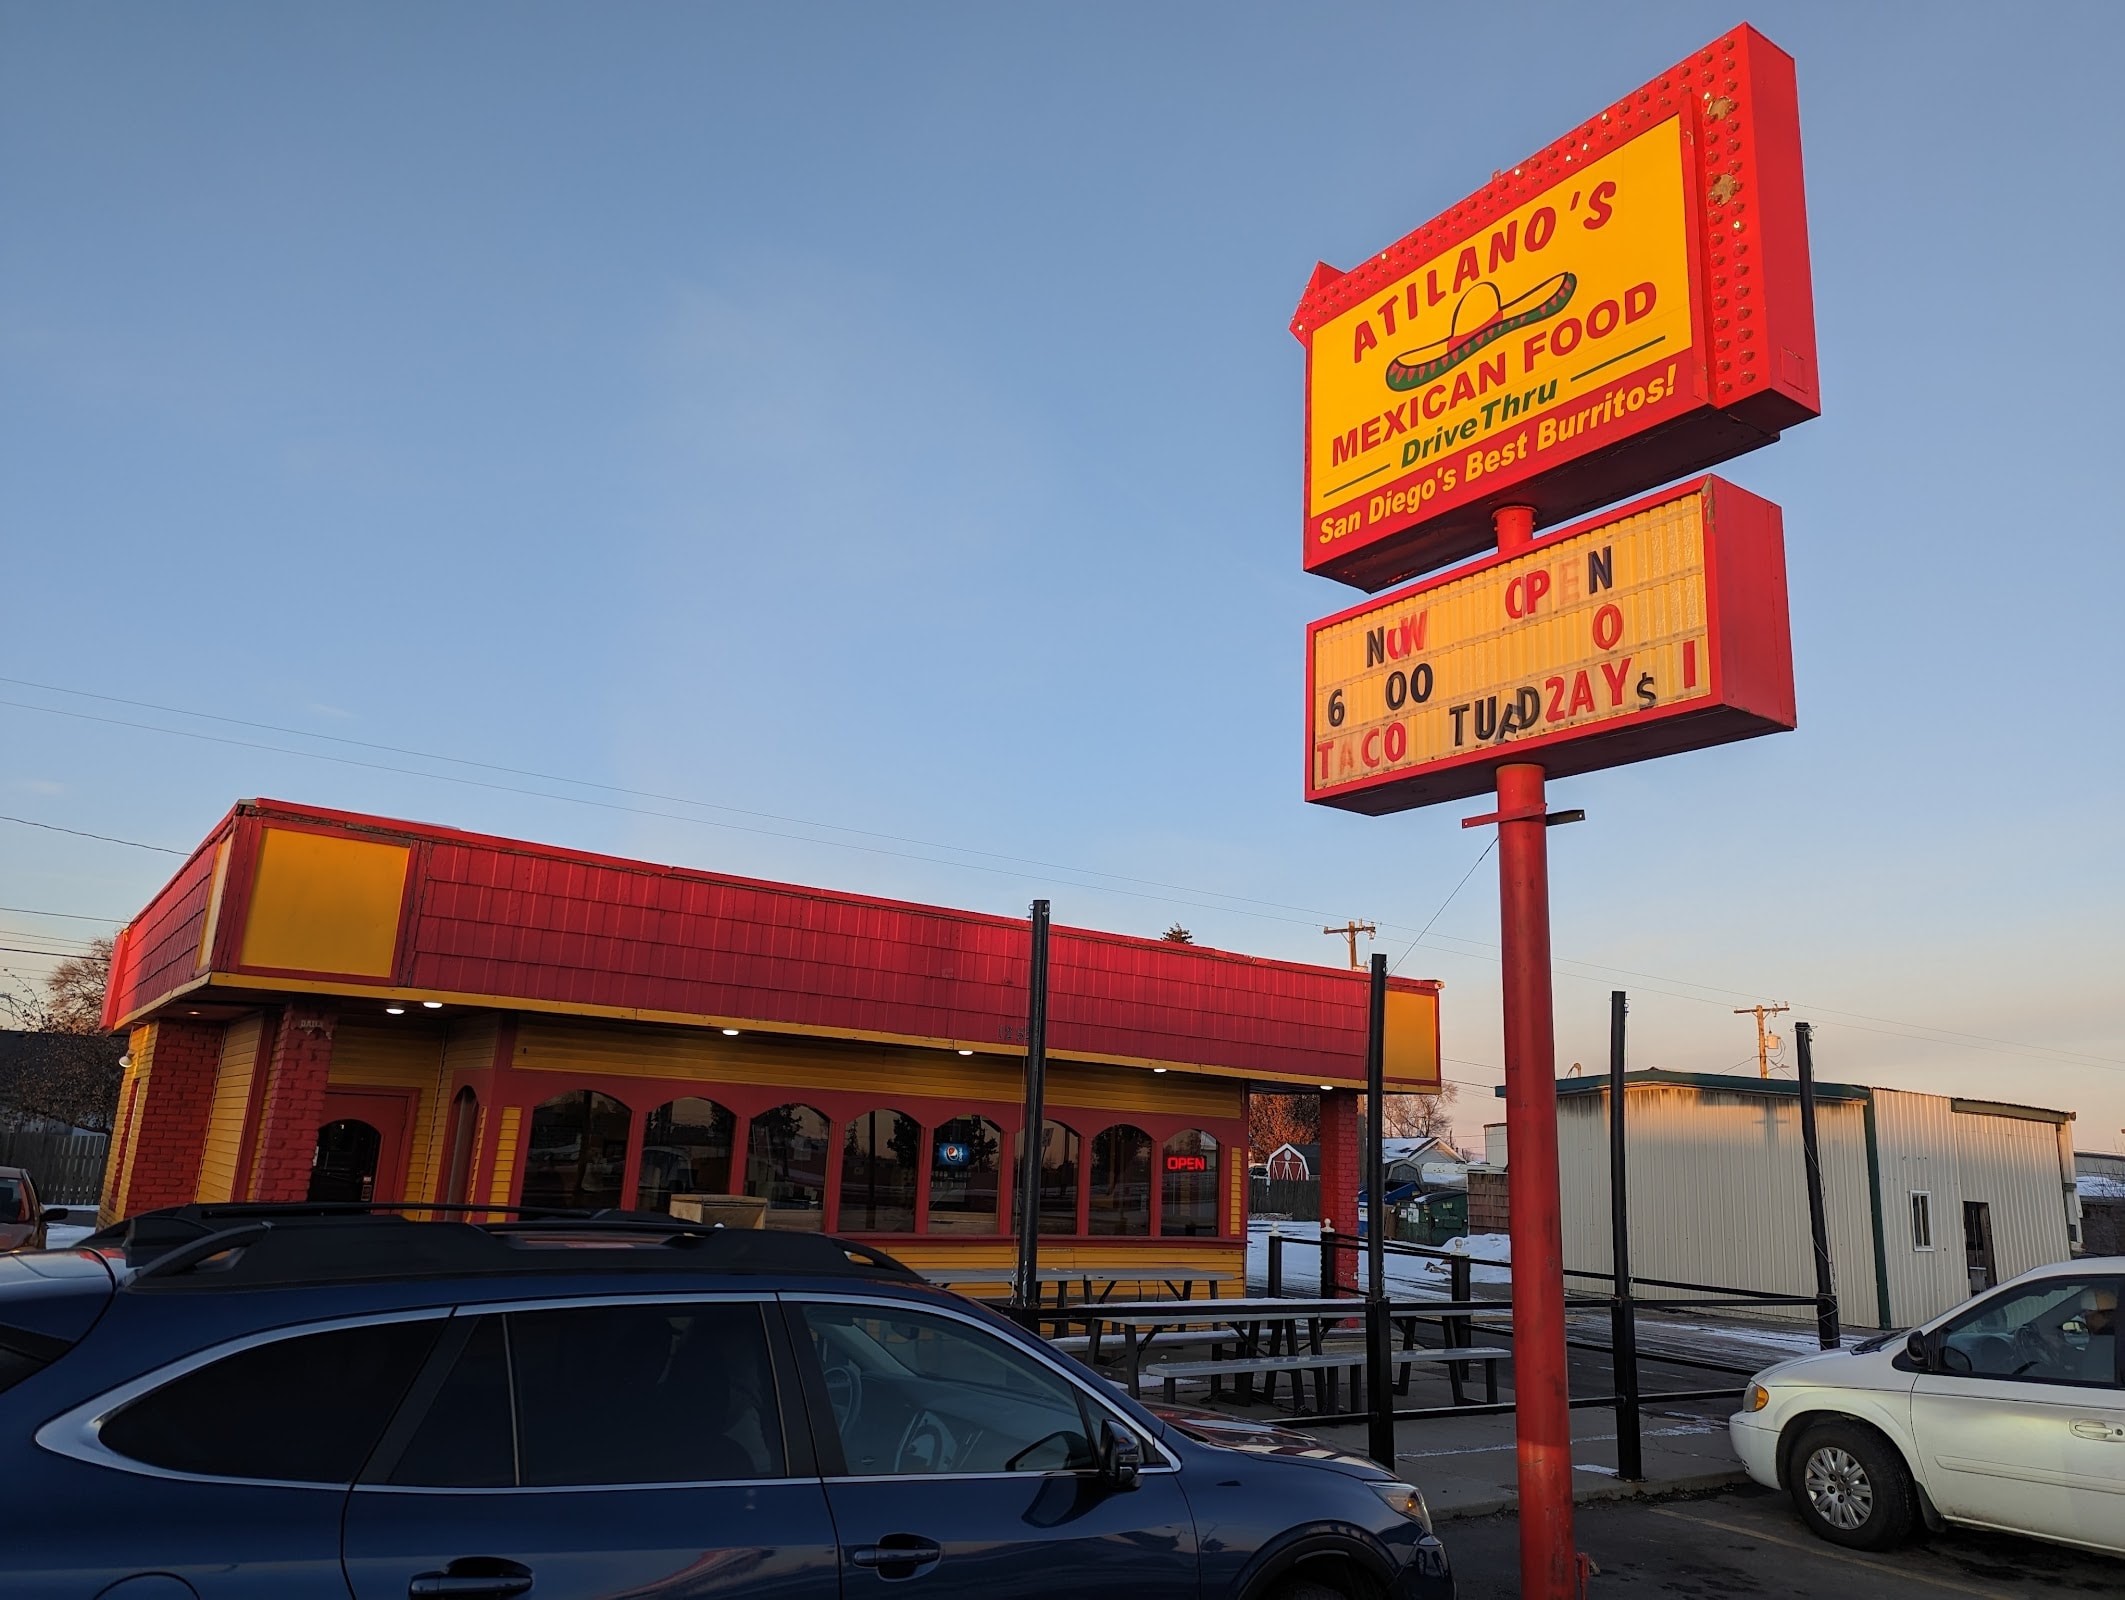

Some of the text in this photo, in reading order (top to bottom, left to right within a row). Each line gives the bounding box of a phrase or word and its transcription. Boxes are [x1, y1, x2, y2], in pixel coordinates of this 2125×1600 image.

[1354, 181, 1617, 364] ATILANO'S
[1332, 281, 1657, 468] MEXICAN FOOD
[1319, 362, 1677, 544] San Diego's Best Burritos!
[1366, 545, 1613, 668] NOW OPEN
[1316, 721, 1406, 780] TACO
[1327, 688, 1345, 727] 6
[1167, 1156, 1205, 1170] OPEN
